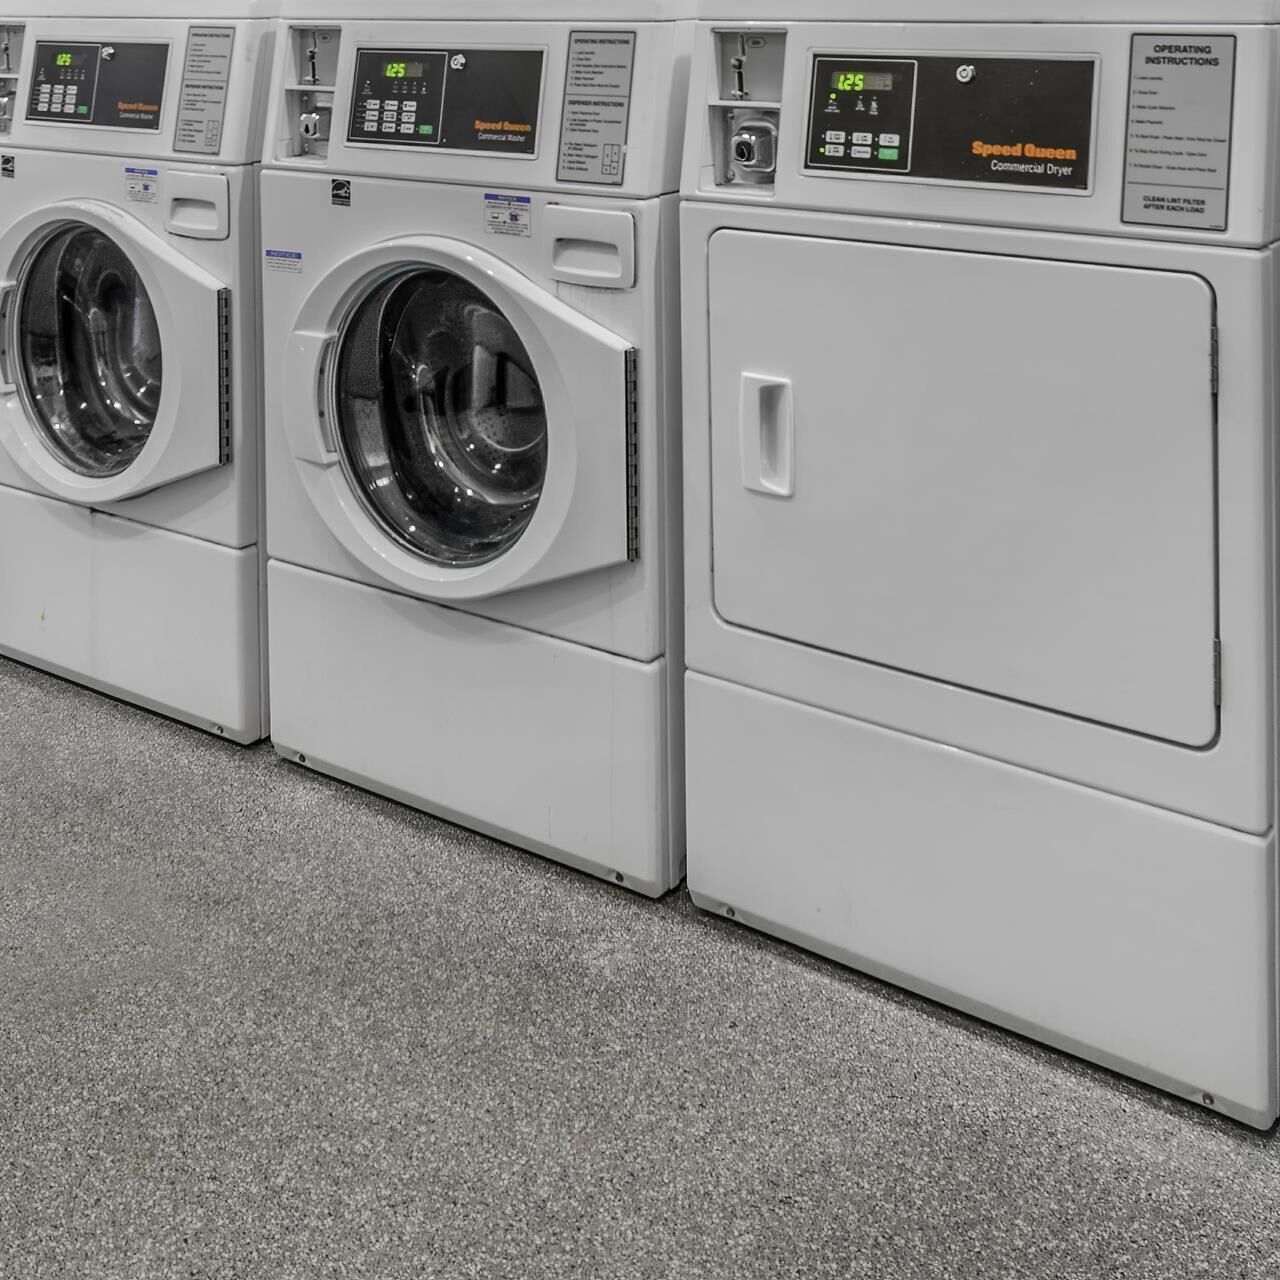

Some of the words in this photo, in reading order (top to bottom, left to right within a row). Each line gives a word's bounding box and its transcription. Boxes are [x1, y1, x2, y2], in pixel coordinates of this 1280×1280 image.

[1153, 44, 1212, 54] OPERATING
[1145, 56, 1220, 66] INSTRUCTIONS
[972, 140, 1022, 157] Speed
[1024, 143, 1077, 160] Queen
[991, 160, 1044, 173] Commercial
[1047, 163, 1073, 176] Dryer
